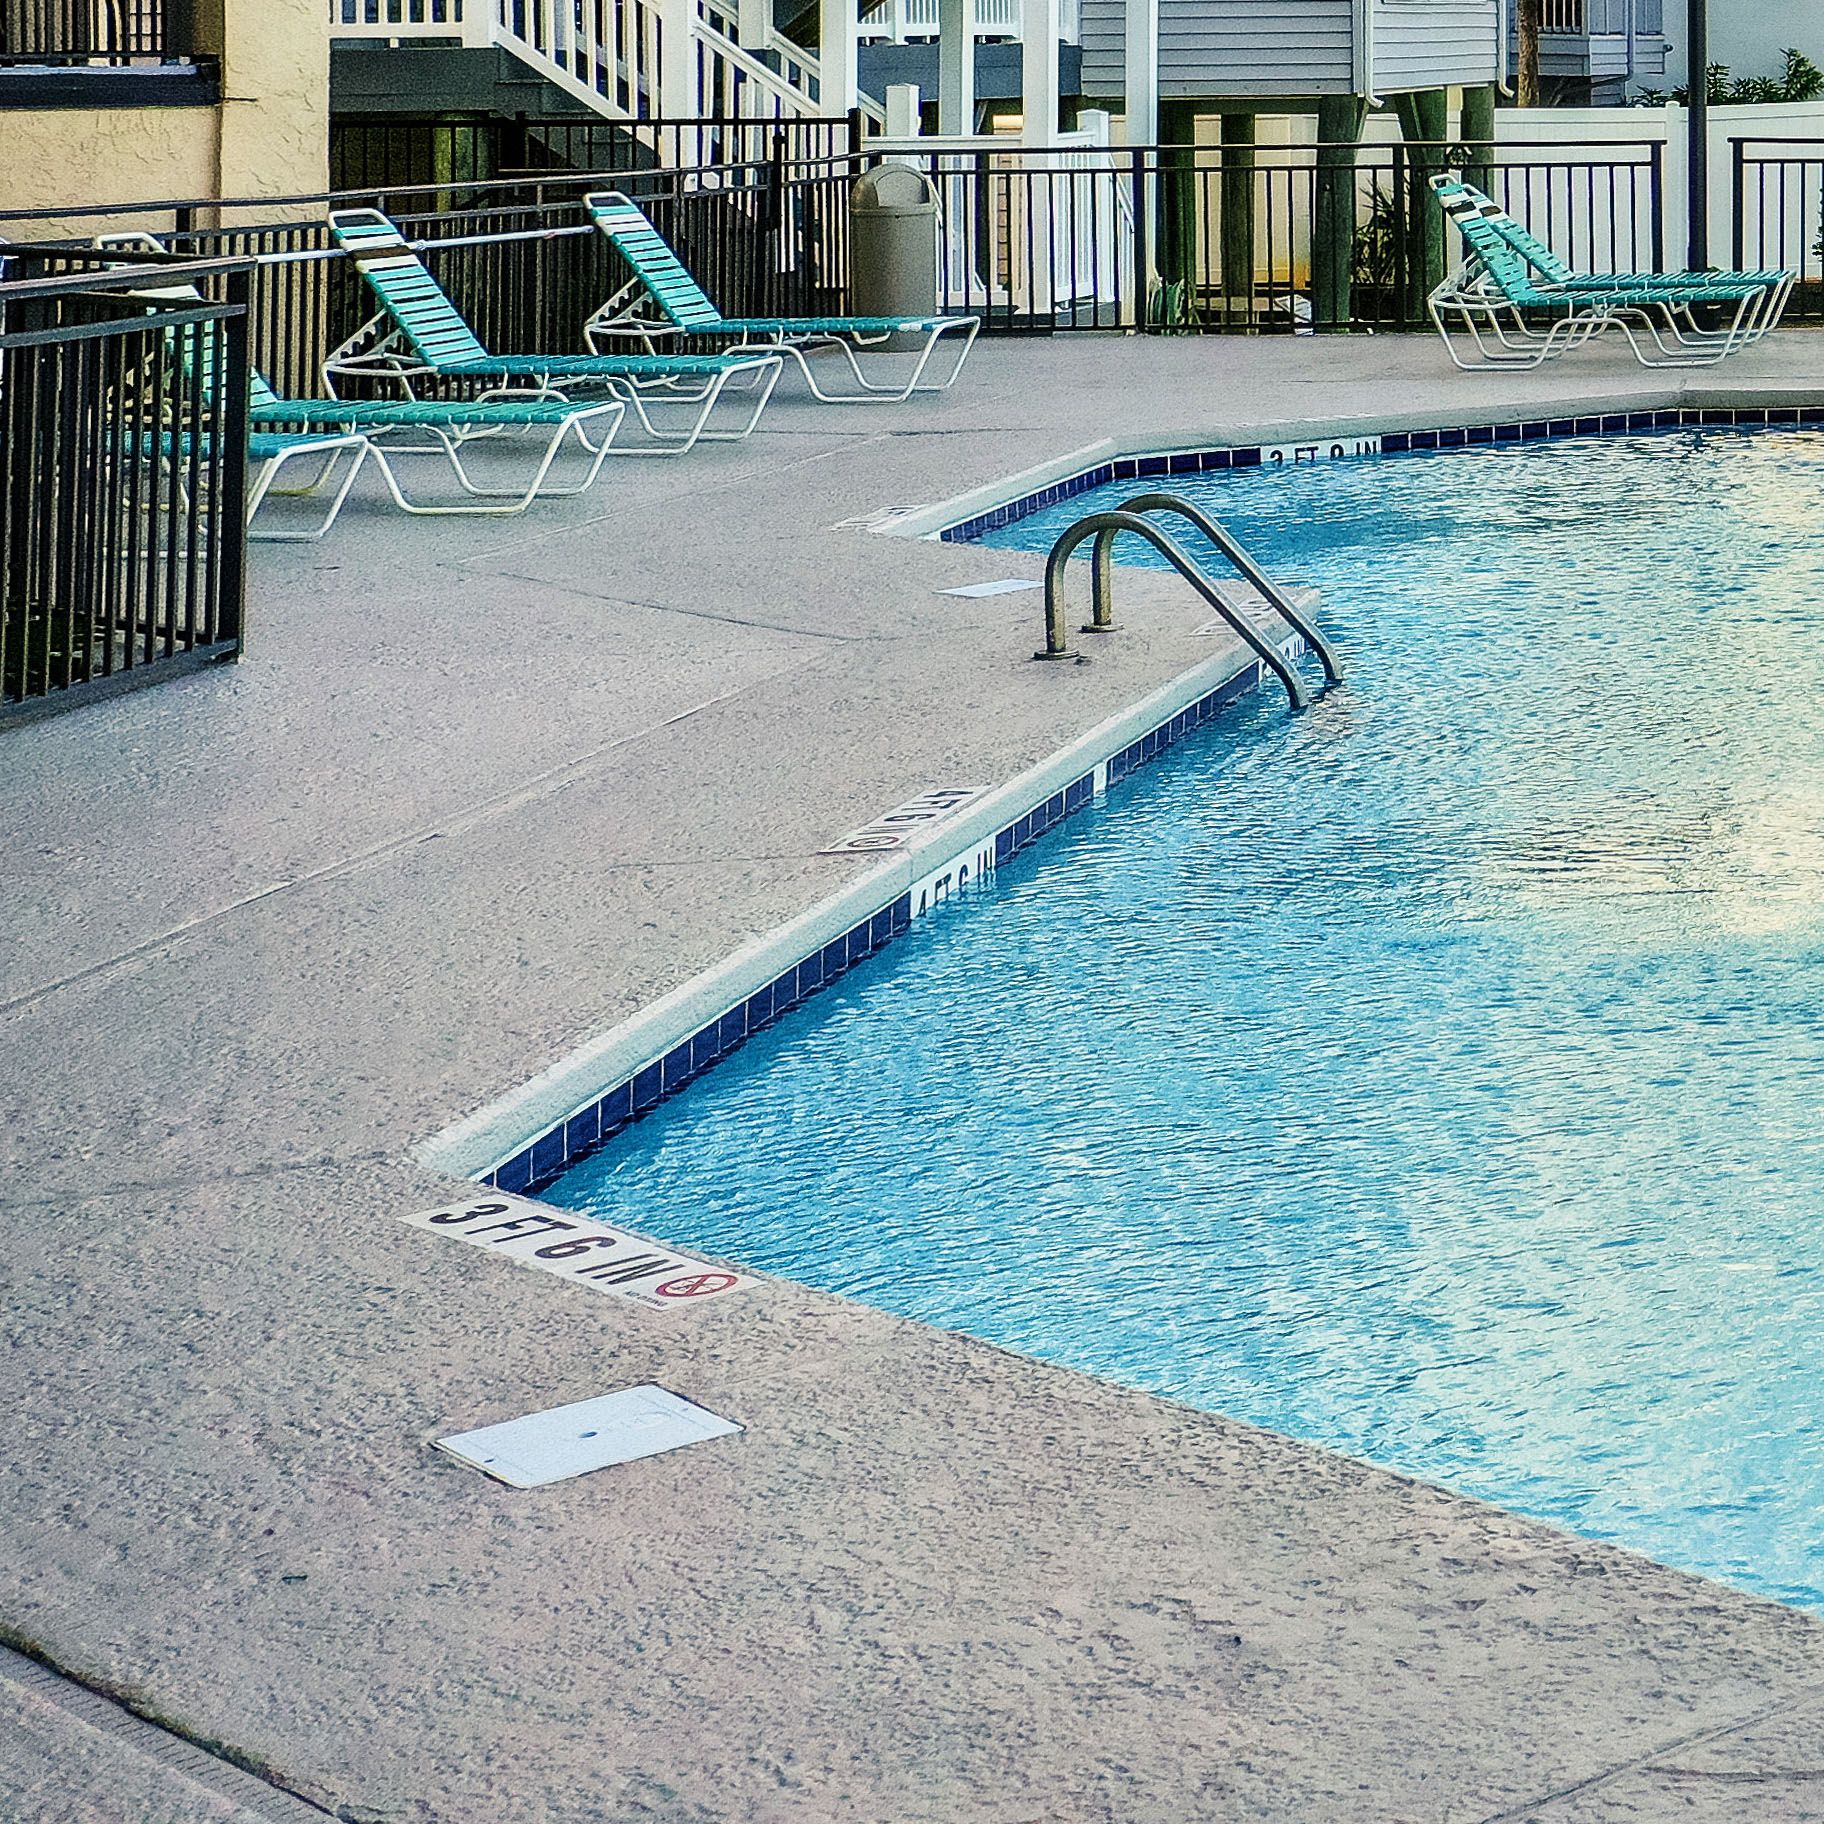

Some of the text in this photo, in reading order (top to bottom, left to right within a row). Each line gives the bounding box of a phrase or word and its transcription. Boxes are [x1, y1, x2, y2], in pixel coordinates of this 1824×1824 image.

[429, 1203, 686, 1285] 3 FT 6 IN
